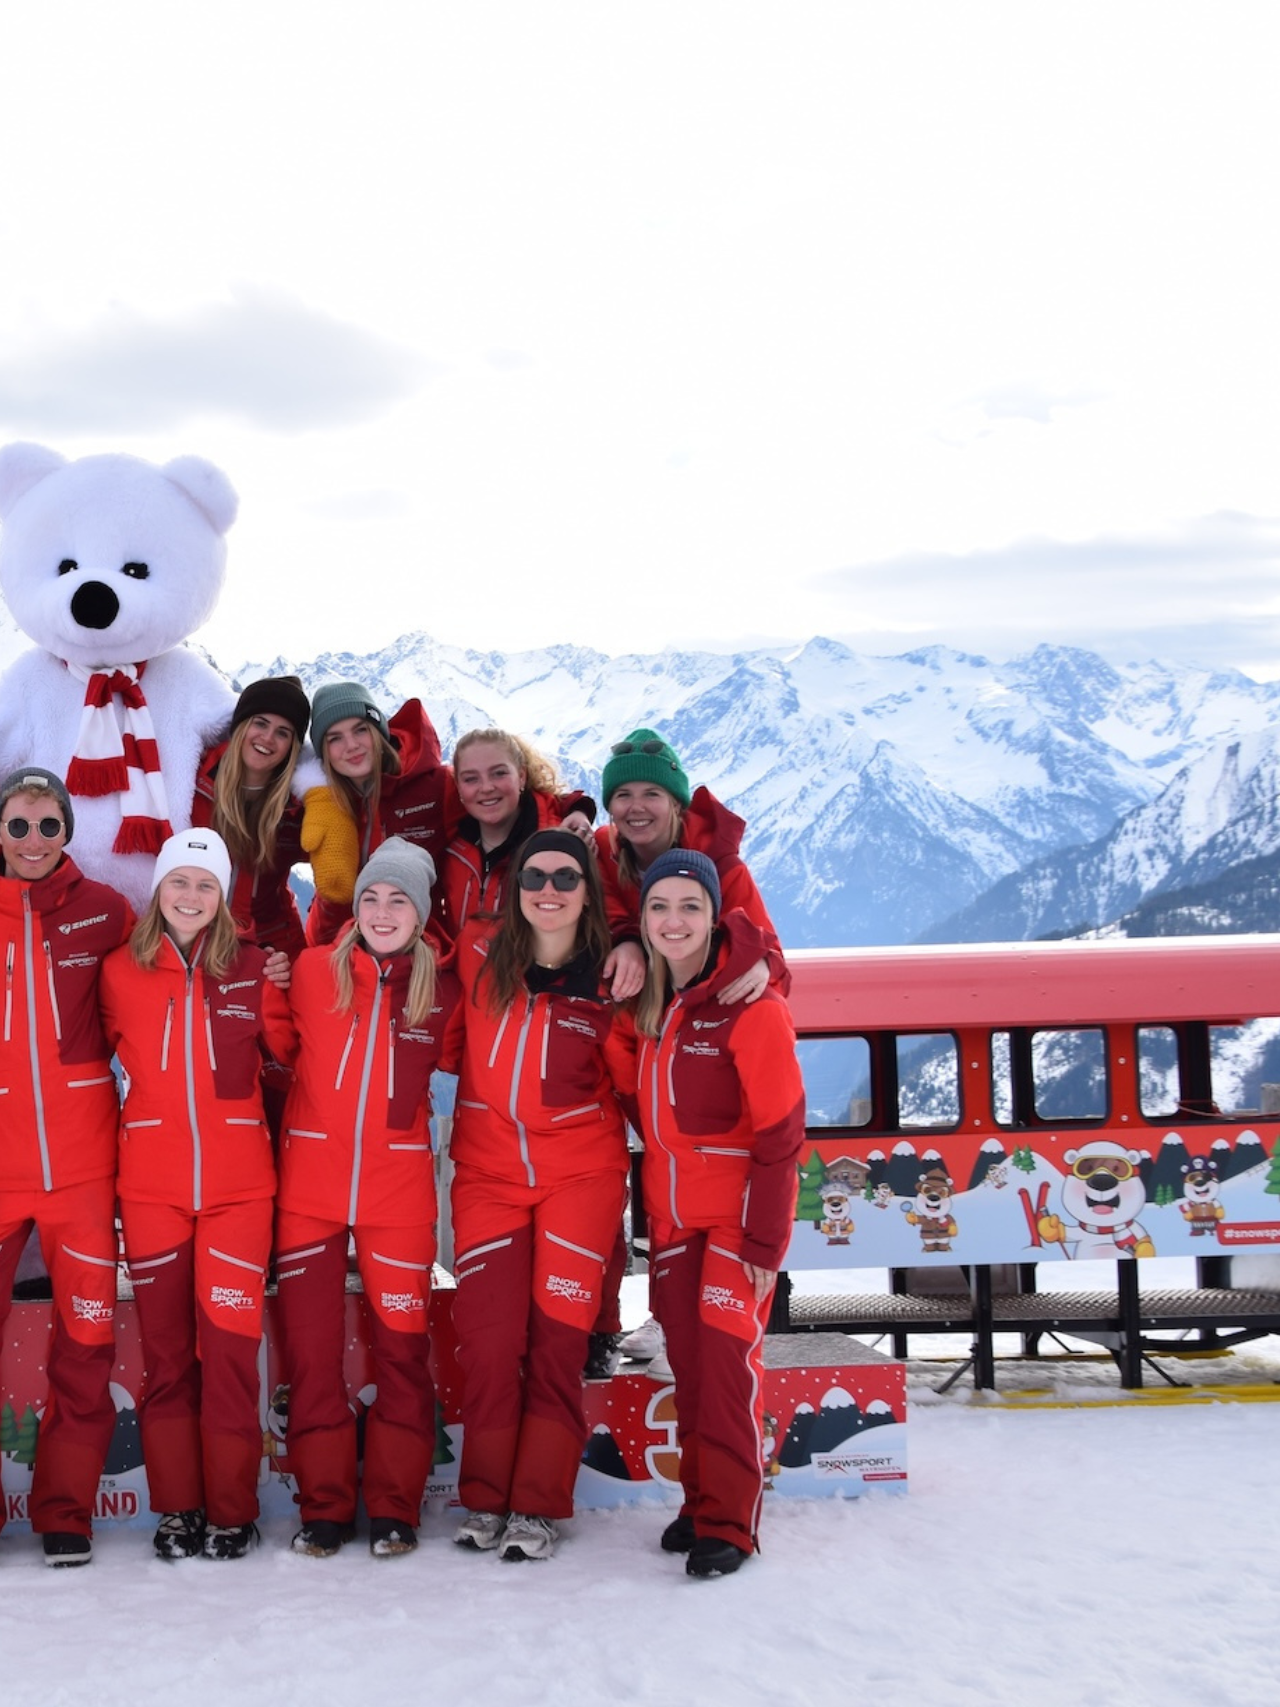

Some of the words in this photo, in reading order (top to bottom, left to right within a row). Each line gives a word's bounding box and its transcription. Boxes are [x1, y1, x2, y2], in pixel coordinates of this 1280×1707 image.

[1224, 1228, 1280, 1240] #snowsp
[548, 1274, 582, 1289] SNOW
[211, 1286, 245, 1298] SNOW
[381, 1292, 413, 1301] SNOW
[545, 1282, 592, 1300] SPORTS
[704, 1284, 734, 1298] SNOW
[210, 1294, 253, 1305] SPORTS
[381, 1299, 424, 1308] SPORTS
[702, 1292, 746, 1310] SPORTS
[817, 1457, 893, 1469] SNOWSPORT
